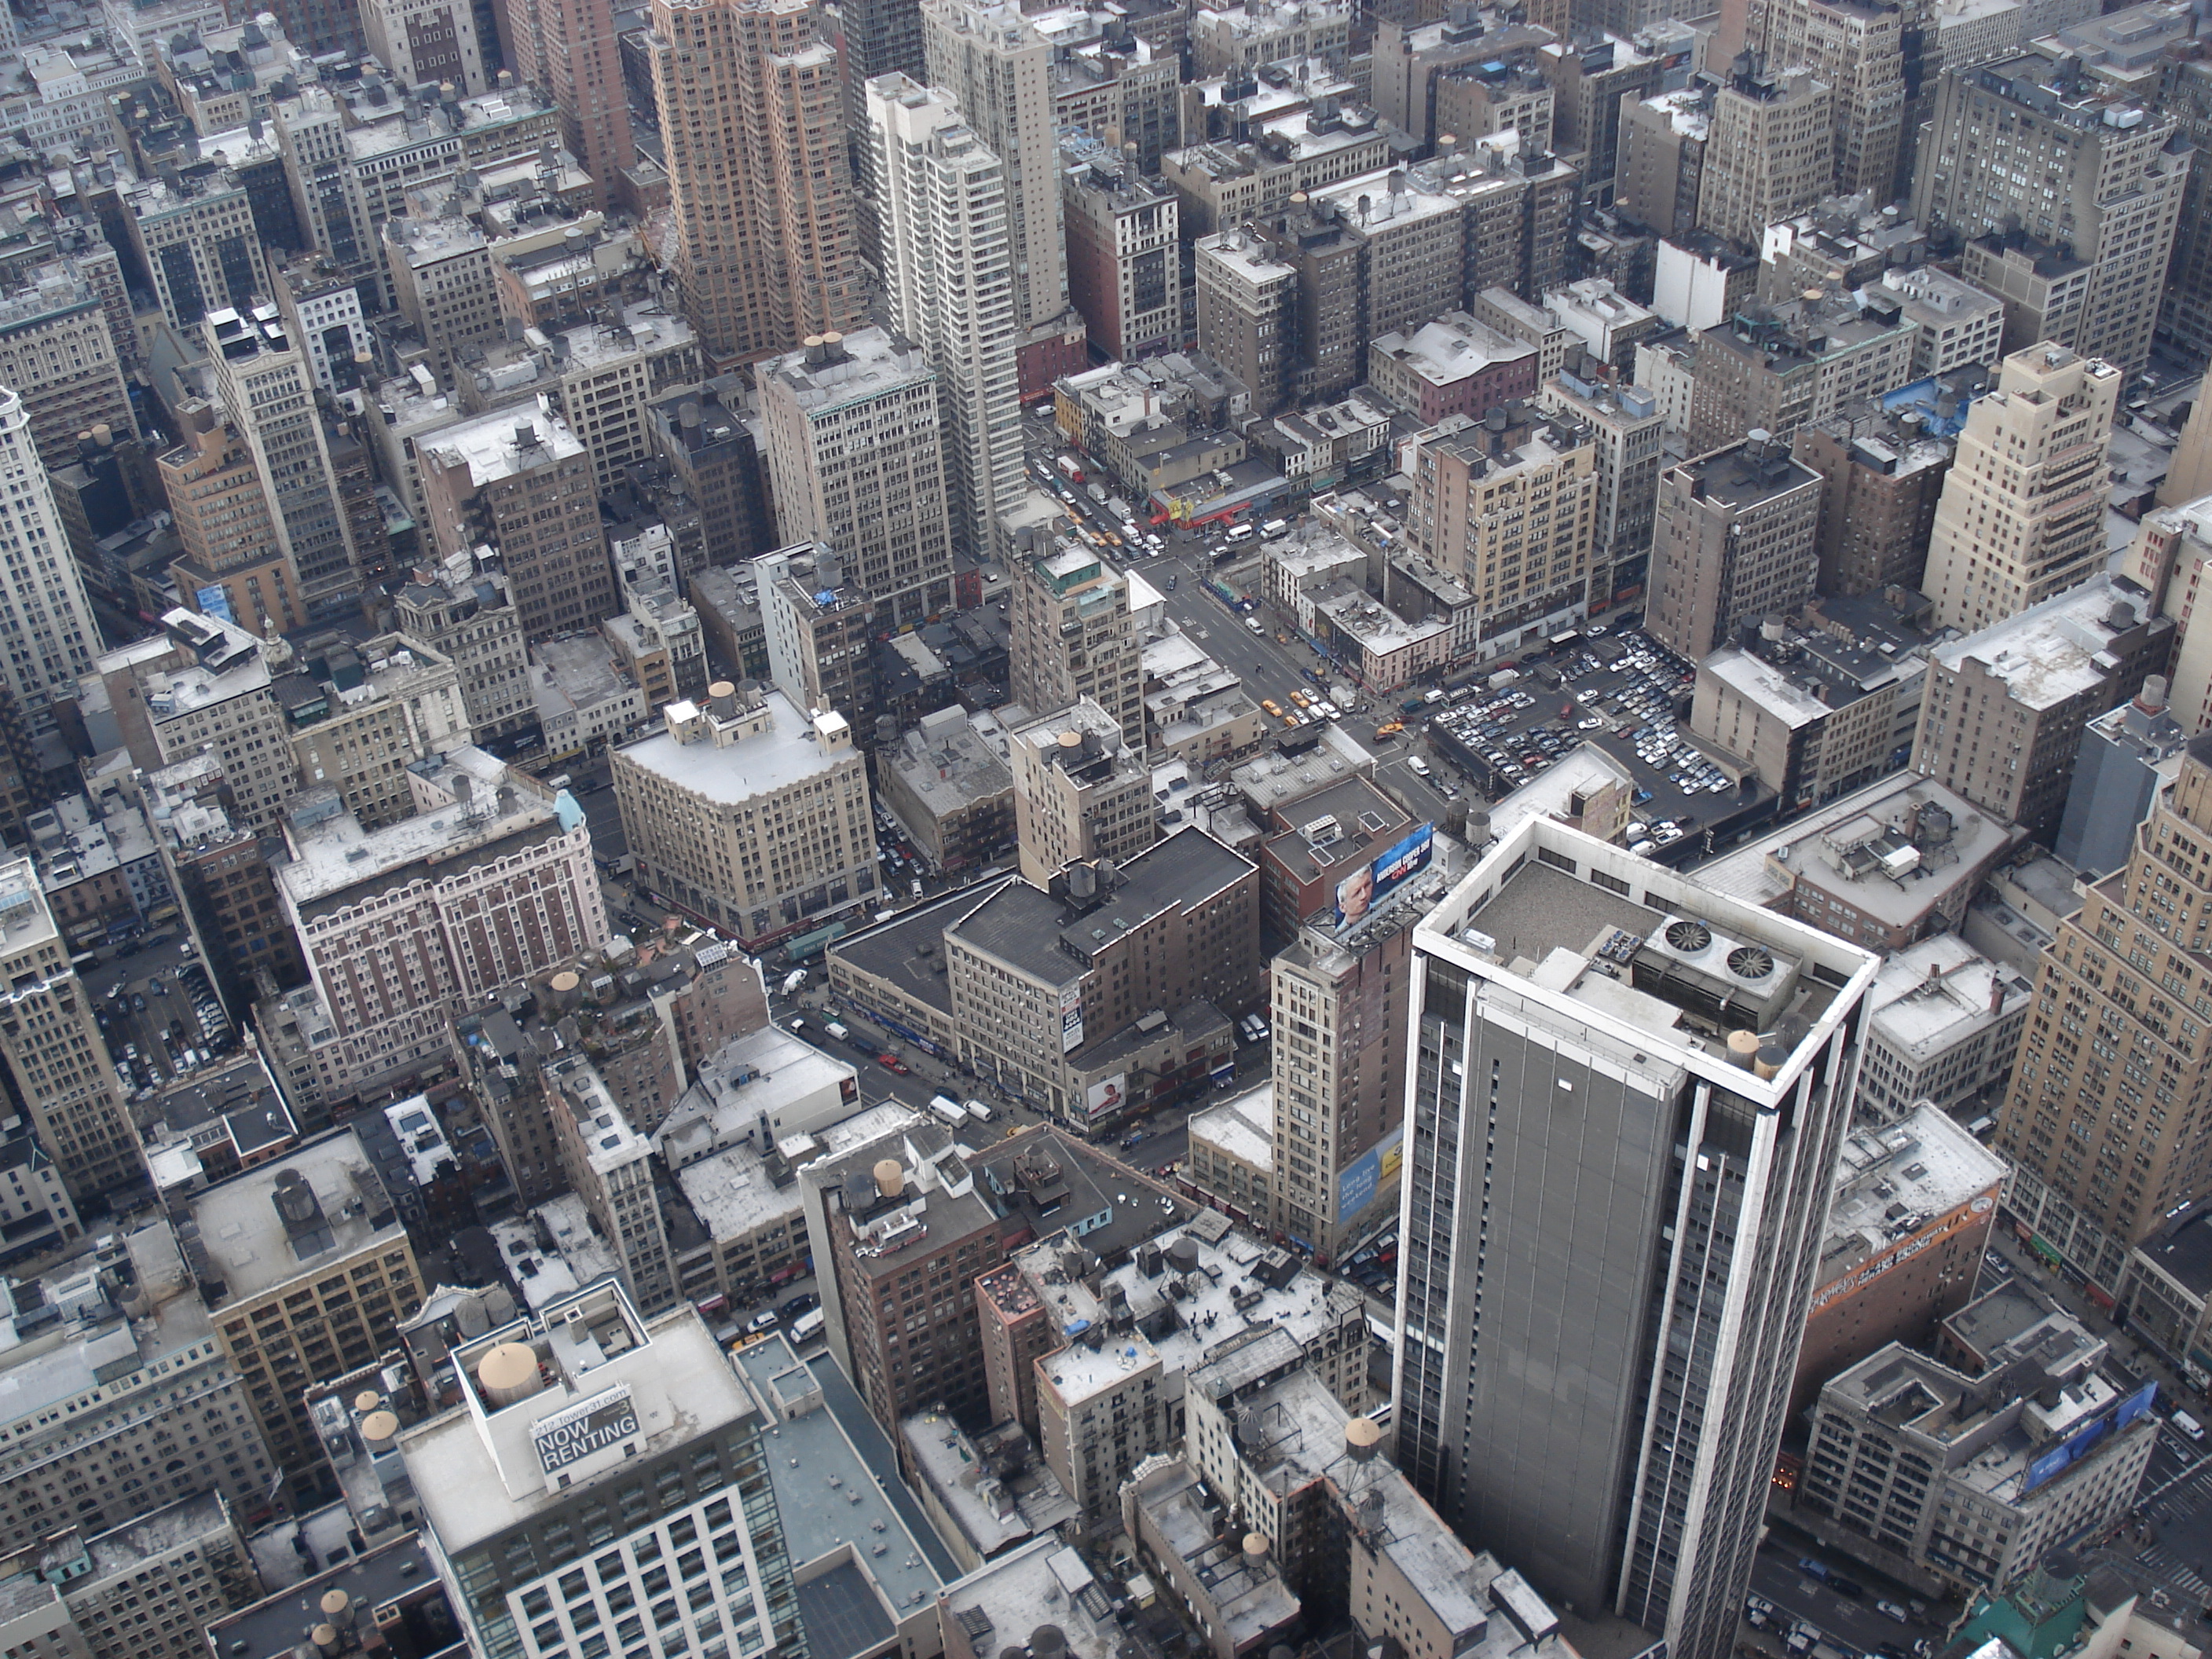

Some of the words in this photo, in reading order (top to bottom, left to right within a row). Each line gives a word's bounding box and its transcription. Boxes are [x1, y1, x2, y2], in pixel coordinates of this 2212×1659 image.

[1402, 846, 1420, 866] COOPER
[1391, 865, 1406, 879] CNN
[1342, 1176, 1360, 1192] Long
[1362, 1164, 1375, 1177] live
[1342, 1189, 1353, 1200] the
[1357, 1175, 1372, 1189] long
[538, 1416, 589, 1454] NOW
[543, 1416, 636, 1470] RENTING
